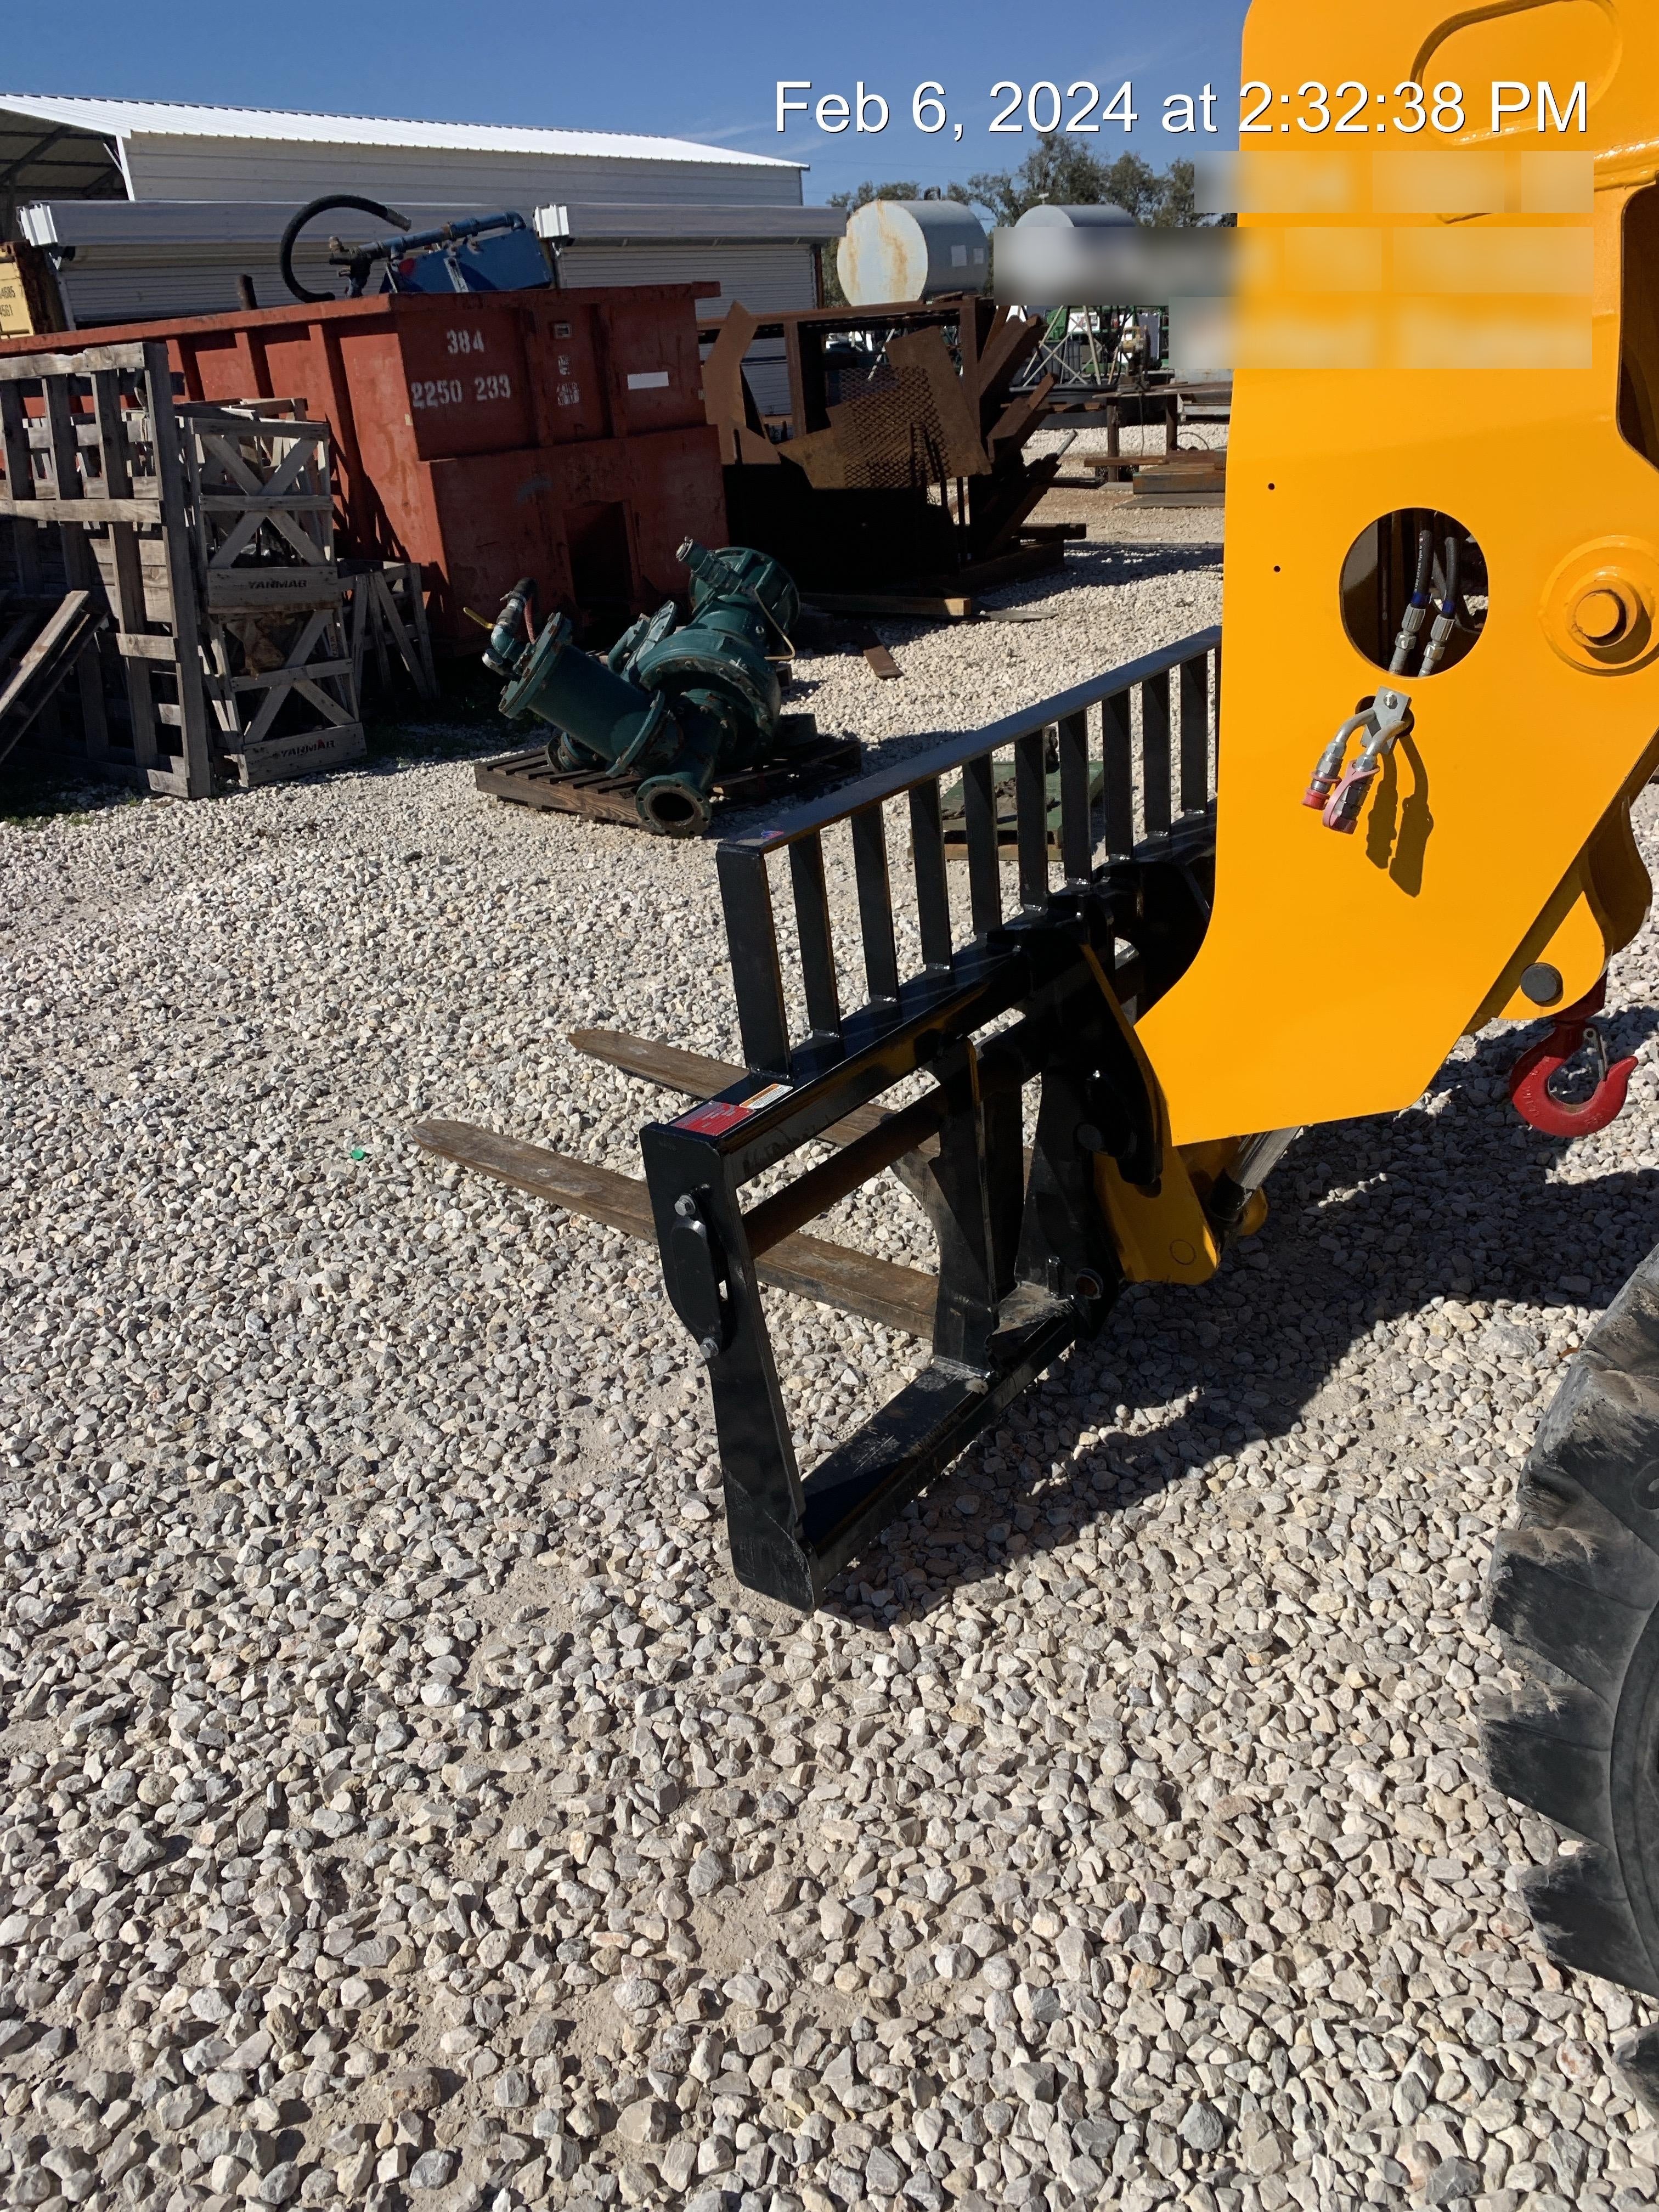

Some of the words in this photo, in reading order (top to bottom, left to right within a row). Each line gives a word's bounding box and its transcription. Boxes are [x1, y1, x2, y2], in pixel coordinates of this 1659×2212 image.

[447, 329, 485, 354] 384
[411, 380, 463, 409] 2250
[474, 374, 511, 402] 233
